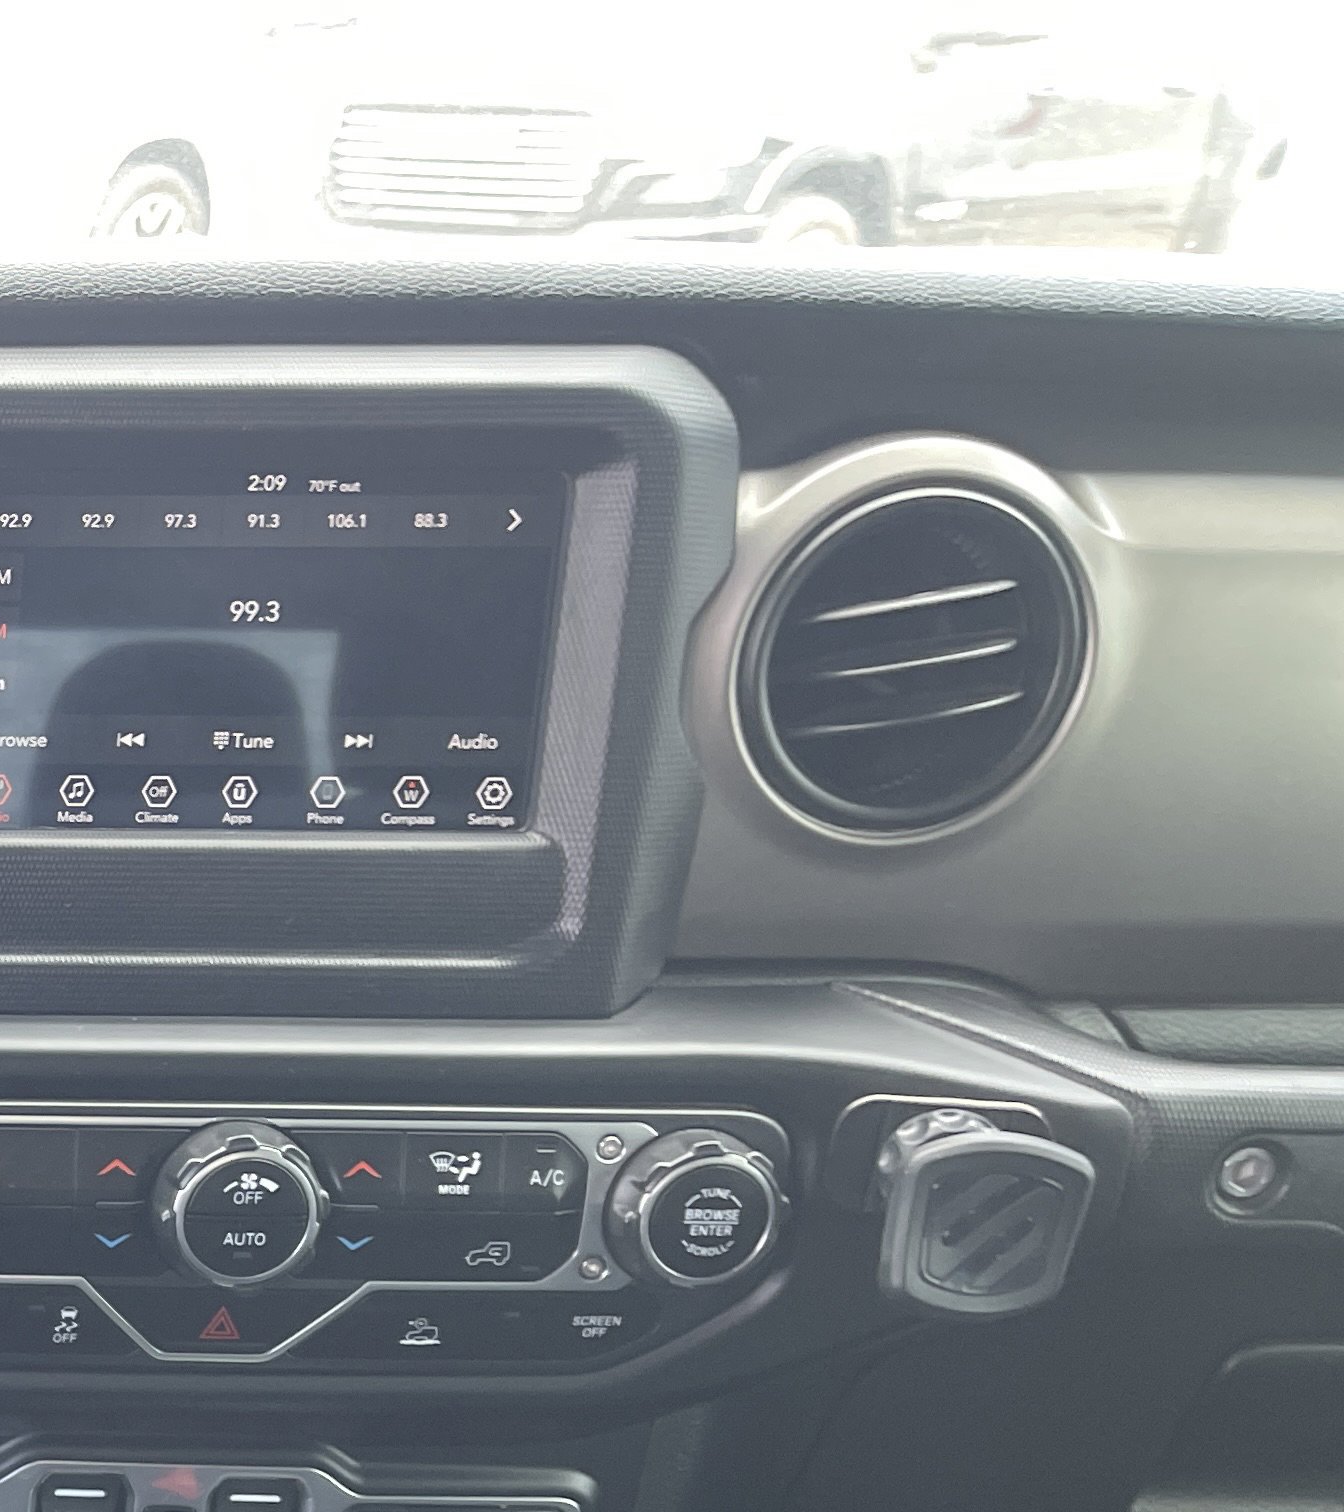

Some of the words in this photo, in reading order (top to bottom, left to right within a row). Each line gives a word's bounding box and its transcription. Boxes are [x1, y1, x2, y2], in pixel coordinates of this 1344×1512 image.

[247, 475, 288, 493] 2:09
[339, 481, 362, 493] out
[0, 513, 33, 530] 92.9
[81, 513, 115, 530] 92.9
[164, 513, 198, 530] 97.3
[247, 513, 281, 530] 91.3
[327, 513, 368, 530] 106.1
[413, 513, 449, 530] 88.3
[229, 600, 281, 623] 99.3
[232, 732, 275, 750] Tune
[447, 733, 499, 751] Audio
[56, 810, 94, 824] Media
[134, 810, 180, 825] Climate
[221, 811, 254, 826] Apps
[306, 811, 345, 825] Phone
[380, 811, 436, 827] Compass
[529, 1168, 566, 1189] A/C
[233, 1190, 264, 1206] OFF
[437, 1184, 471, 1196] MODE
[685, 1208, 741, 1222] BROWSE
[223, 1231, 267, 1248] AUTO
[689, 1225, 734, 1238] ENTER
[571, 1315, 623, 1328] SCREEN
[52, 1331, 78, 1344] OFF
[581, 1327, 607, 1339] OFF
